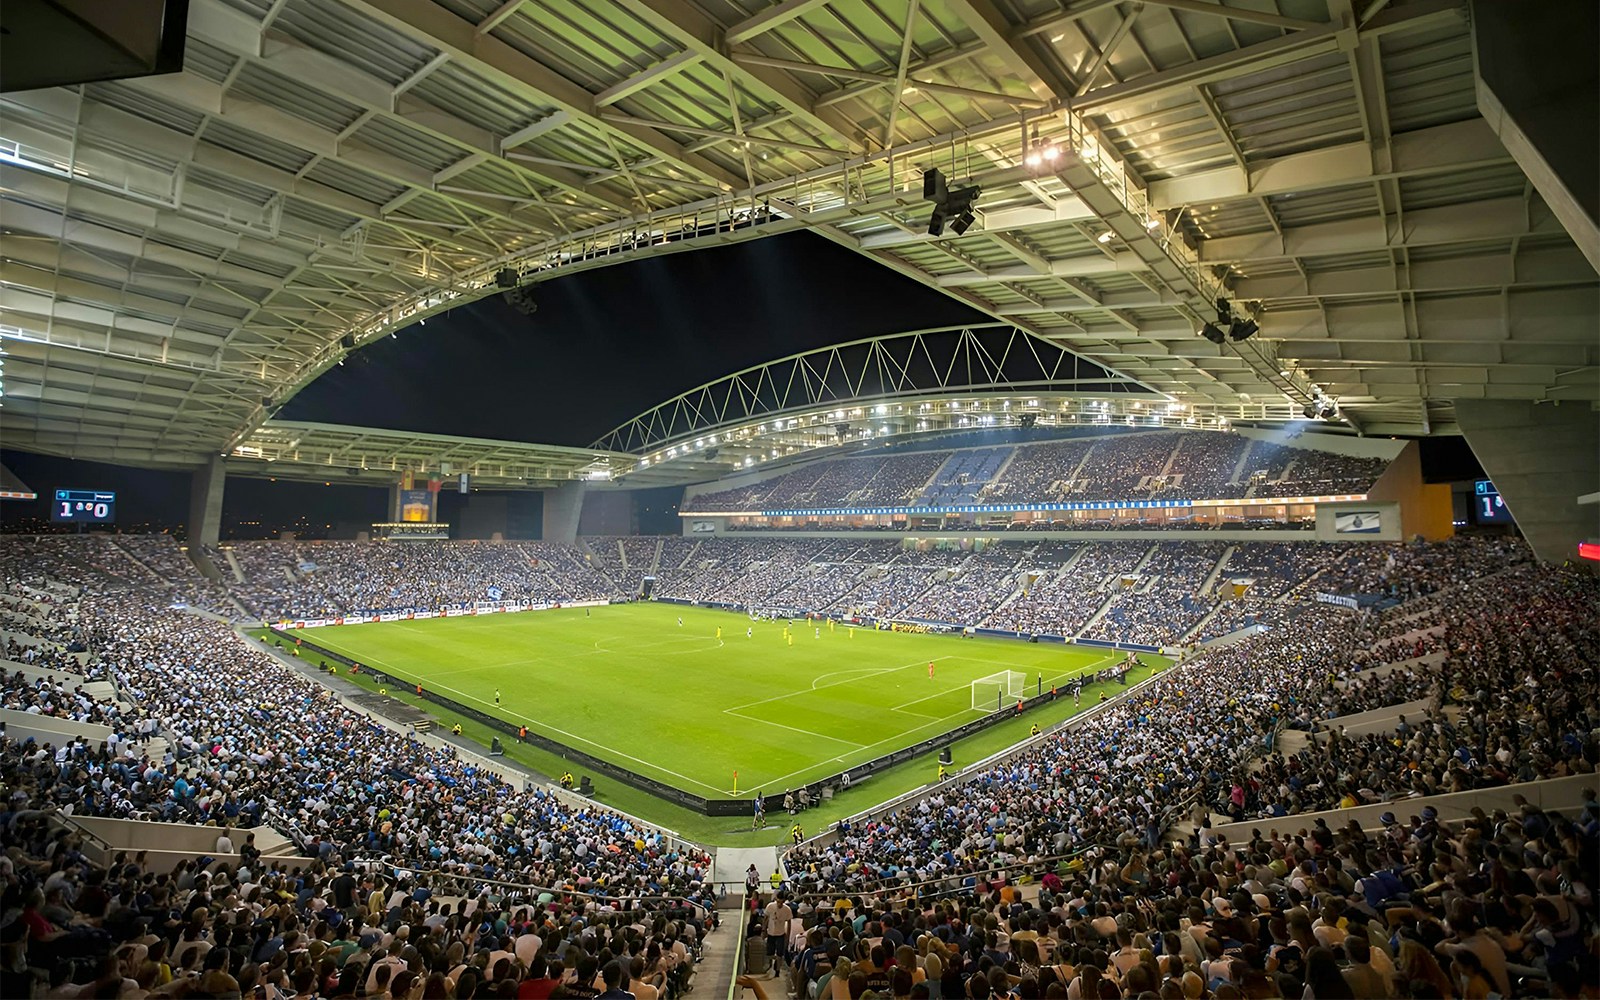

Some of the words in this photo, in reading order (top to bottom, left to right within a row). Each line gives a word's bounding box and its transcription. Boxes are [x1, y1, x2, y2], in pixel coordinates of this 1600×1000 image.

[60, 502, 73, 517] 1
[94, 503, 108, 518] 0
[1482, 497, 1494, 517] 1
